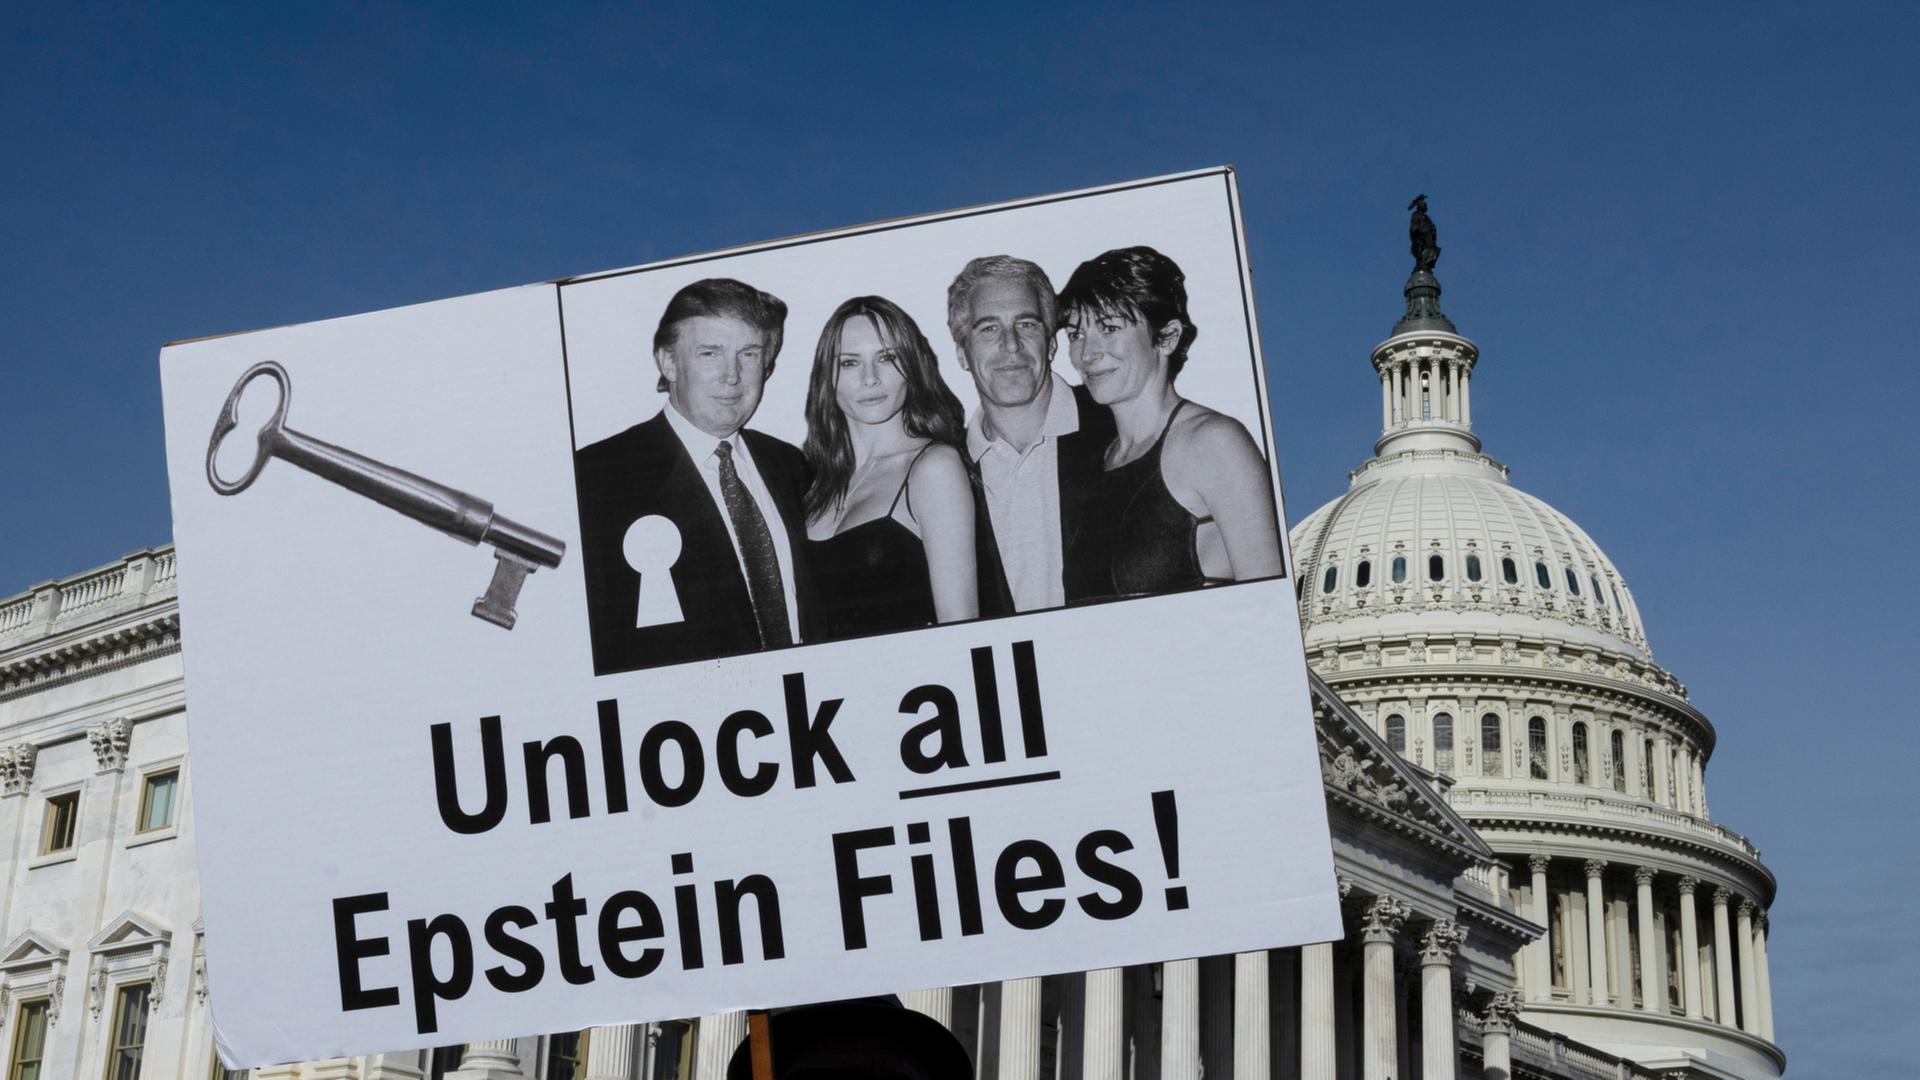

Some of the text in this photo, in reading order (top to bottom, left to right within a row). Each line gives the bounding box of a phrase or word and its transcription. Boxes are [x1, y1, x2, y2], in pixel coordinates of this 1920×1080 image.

[431, 640, 1048, 834] Unlock all
[333, 790, 1189, 1034] Epstein Files!
